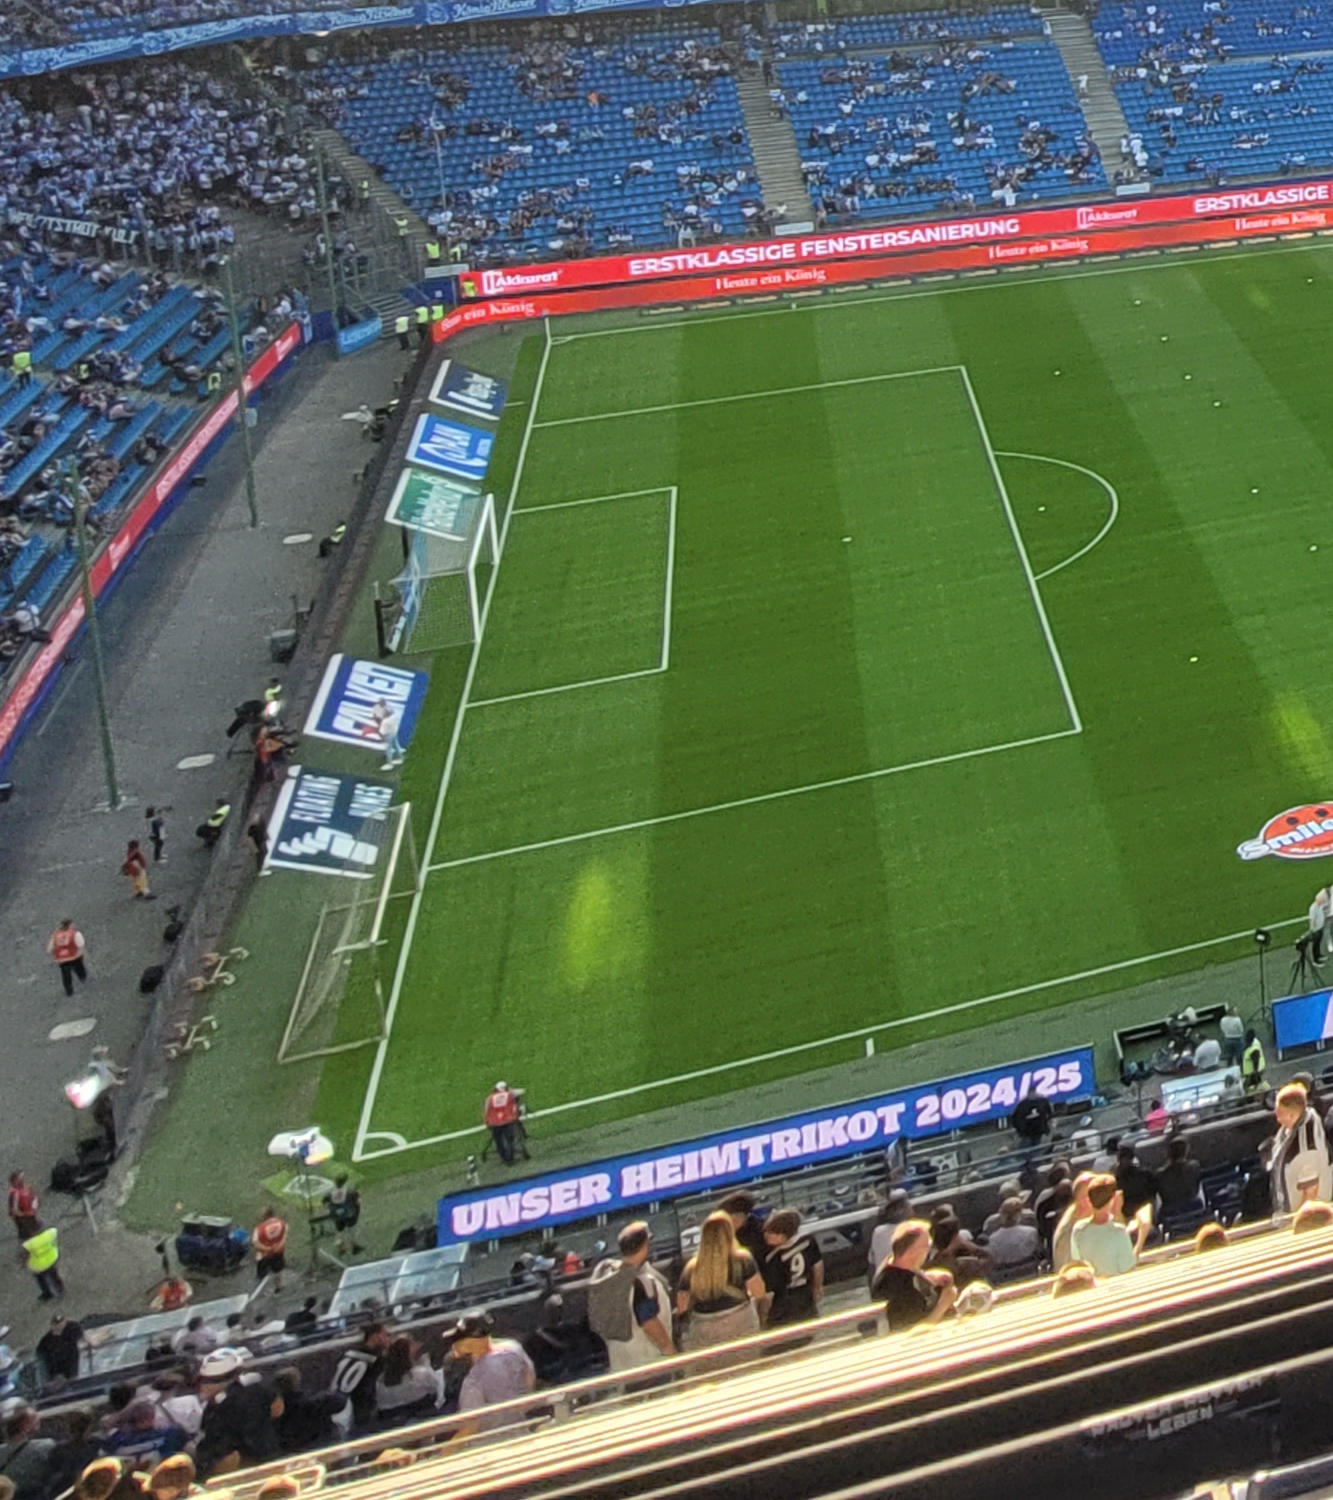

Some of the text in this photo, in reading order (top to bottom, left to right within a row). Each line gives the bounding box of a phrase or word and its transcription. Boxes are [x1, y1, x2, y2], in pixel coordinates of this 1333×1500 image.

[1194, 184, 1330, 213] ERSTKLASSIGE
[630, 218, 1020, 276] ERSTKLASSIGE FENSTERSANIERUNG
[496, 272, 560, 288] Akkurat
[716, 275, 758, 291] Heute
[784, 266, 827, 284] König
[490, 300, 536, 317] König
[450, 1060, 1084, 1237] UNSER HEIMTRIKOT 2024/25
[789, 1250, 805, 1279] 9
[333, 1359, 369, 1395] 10
